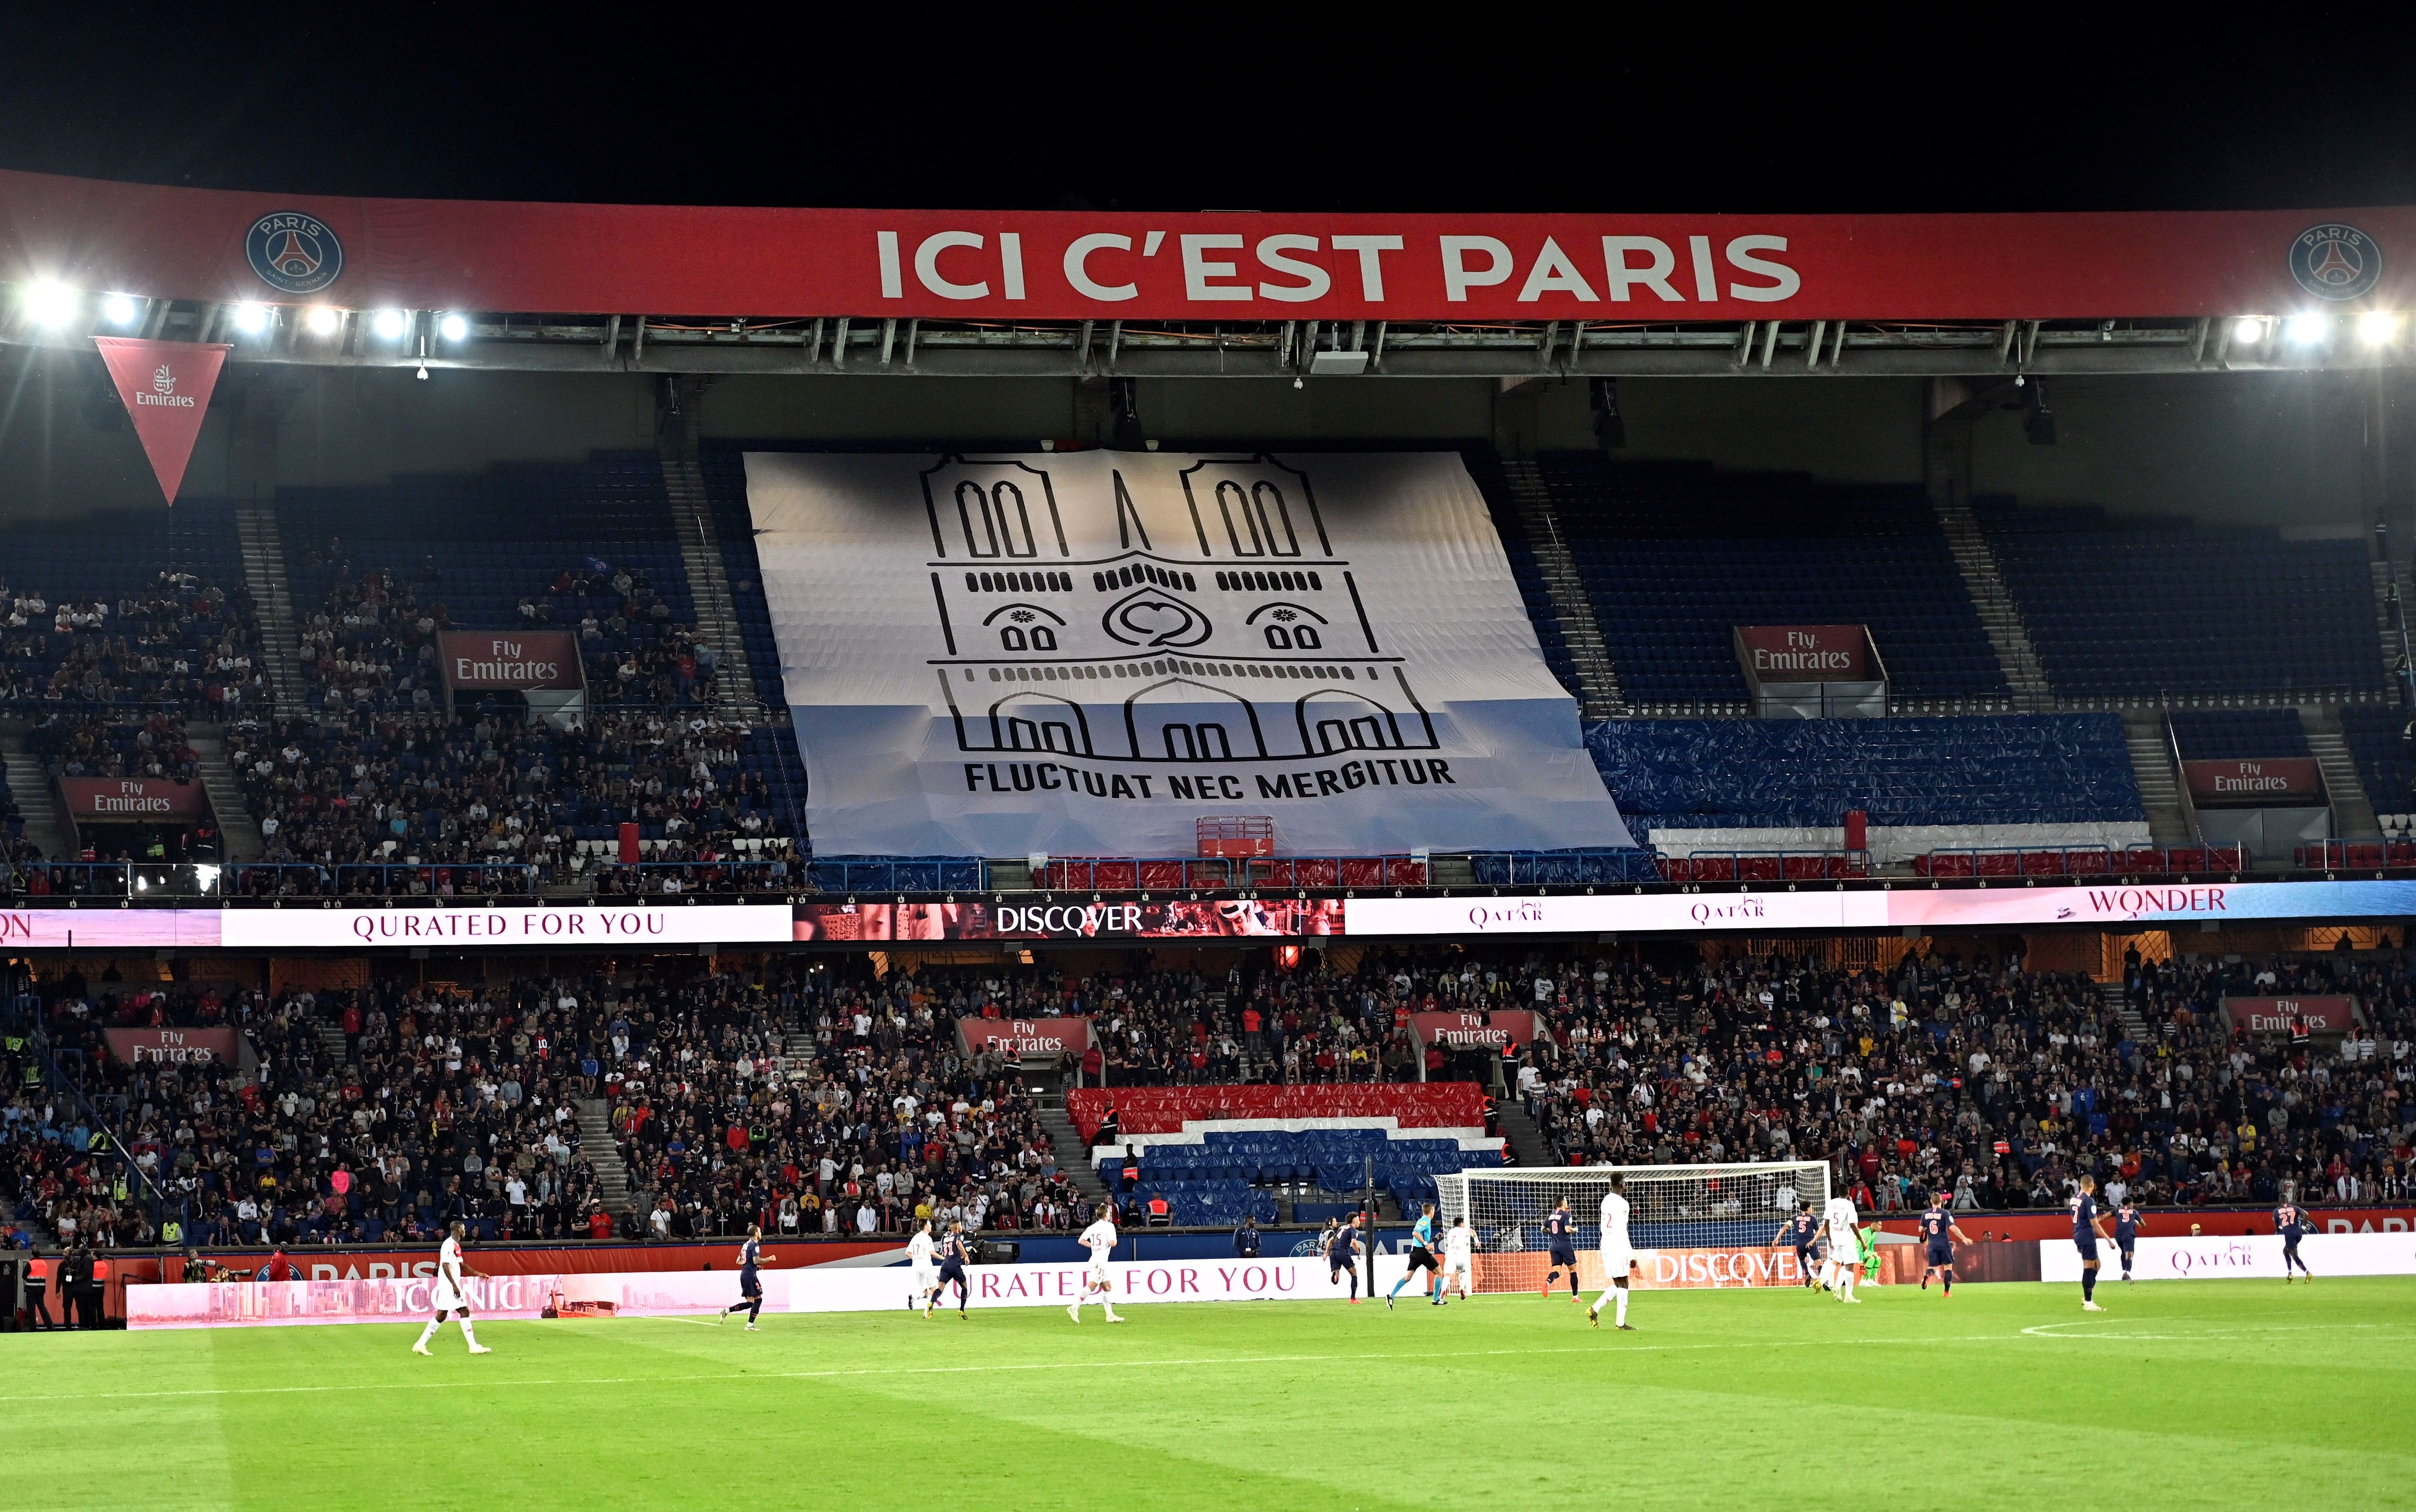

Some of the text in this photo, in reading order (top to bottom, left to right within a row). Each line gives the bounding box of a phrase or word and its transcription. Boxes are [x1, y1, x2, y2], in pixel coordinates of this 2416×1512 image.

[260, 217, 321, 236] PARIS
[2303, 228, 2362, 246] PARIS
[877, 230, 1801, 302] ICI C'EST PARIS
[136, 393, 195, 407] Emirates
[1787, 632, 1815, 649] Fly
[493, 641, 521, 658] Fly
[1754, 648, 1851, 669] Emirates
[457, 658, 558, 679] Emirates
[2239, 763, 2260, 775] Fly
[964, 758, 1456, 800] FLUCTUAT NEC MERGITUR
[2214, 775, 2287, 792] Emirates
[121, 782, 143, 795] Fly
[94, 794, 170, 811] Emirates
[353, 913, 663, 942] QURATED FOR YOU
[2277, 1000, 2299, 1014] Fly
[1013, 1022, 1035, 1036] Fly
[1460, 1015, 1482, 1028] Fly
[2251, 1013, 2326, 1030] Emirtes
[161, 1031, 183, 1045] Fly
[1834, 1212, 1839, 1224] 5
[2072, 1206, 2078, 1223] 7
[2122, 1213, 2130, 1222] 3
[2280, 1212, 2296, 1227] 27
[1552, 1221, 1558, 1234] 8
[1798, 1221, 1806, 1233] 5
[1929, 1220, 1938, 1235] 6
[1091, 1233, 1101, 1246] 15
[1451, 1236, 1456, 1244] 7
[943, 1242, 954, 1257] 31
[1127, 1269, 1199, 1295] FOR
[1218, 1266, 1294, 1292] YOU
